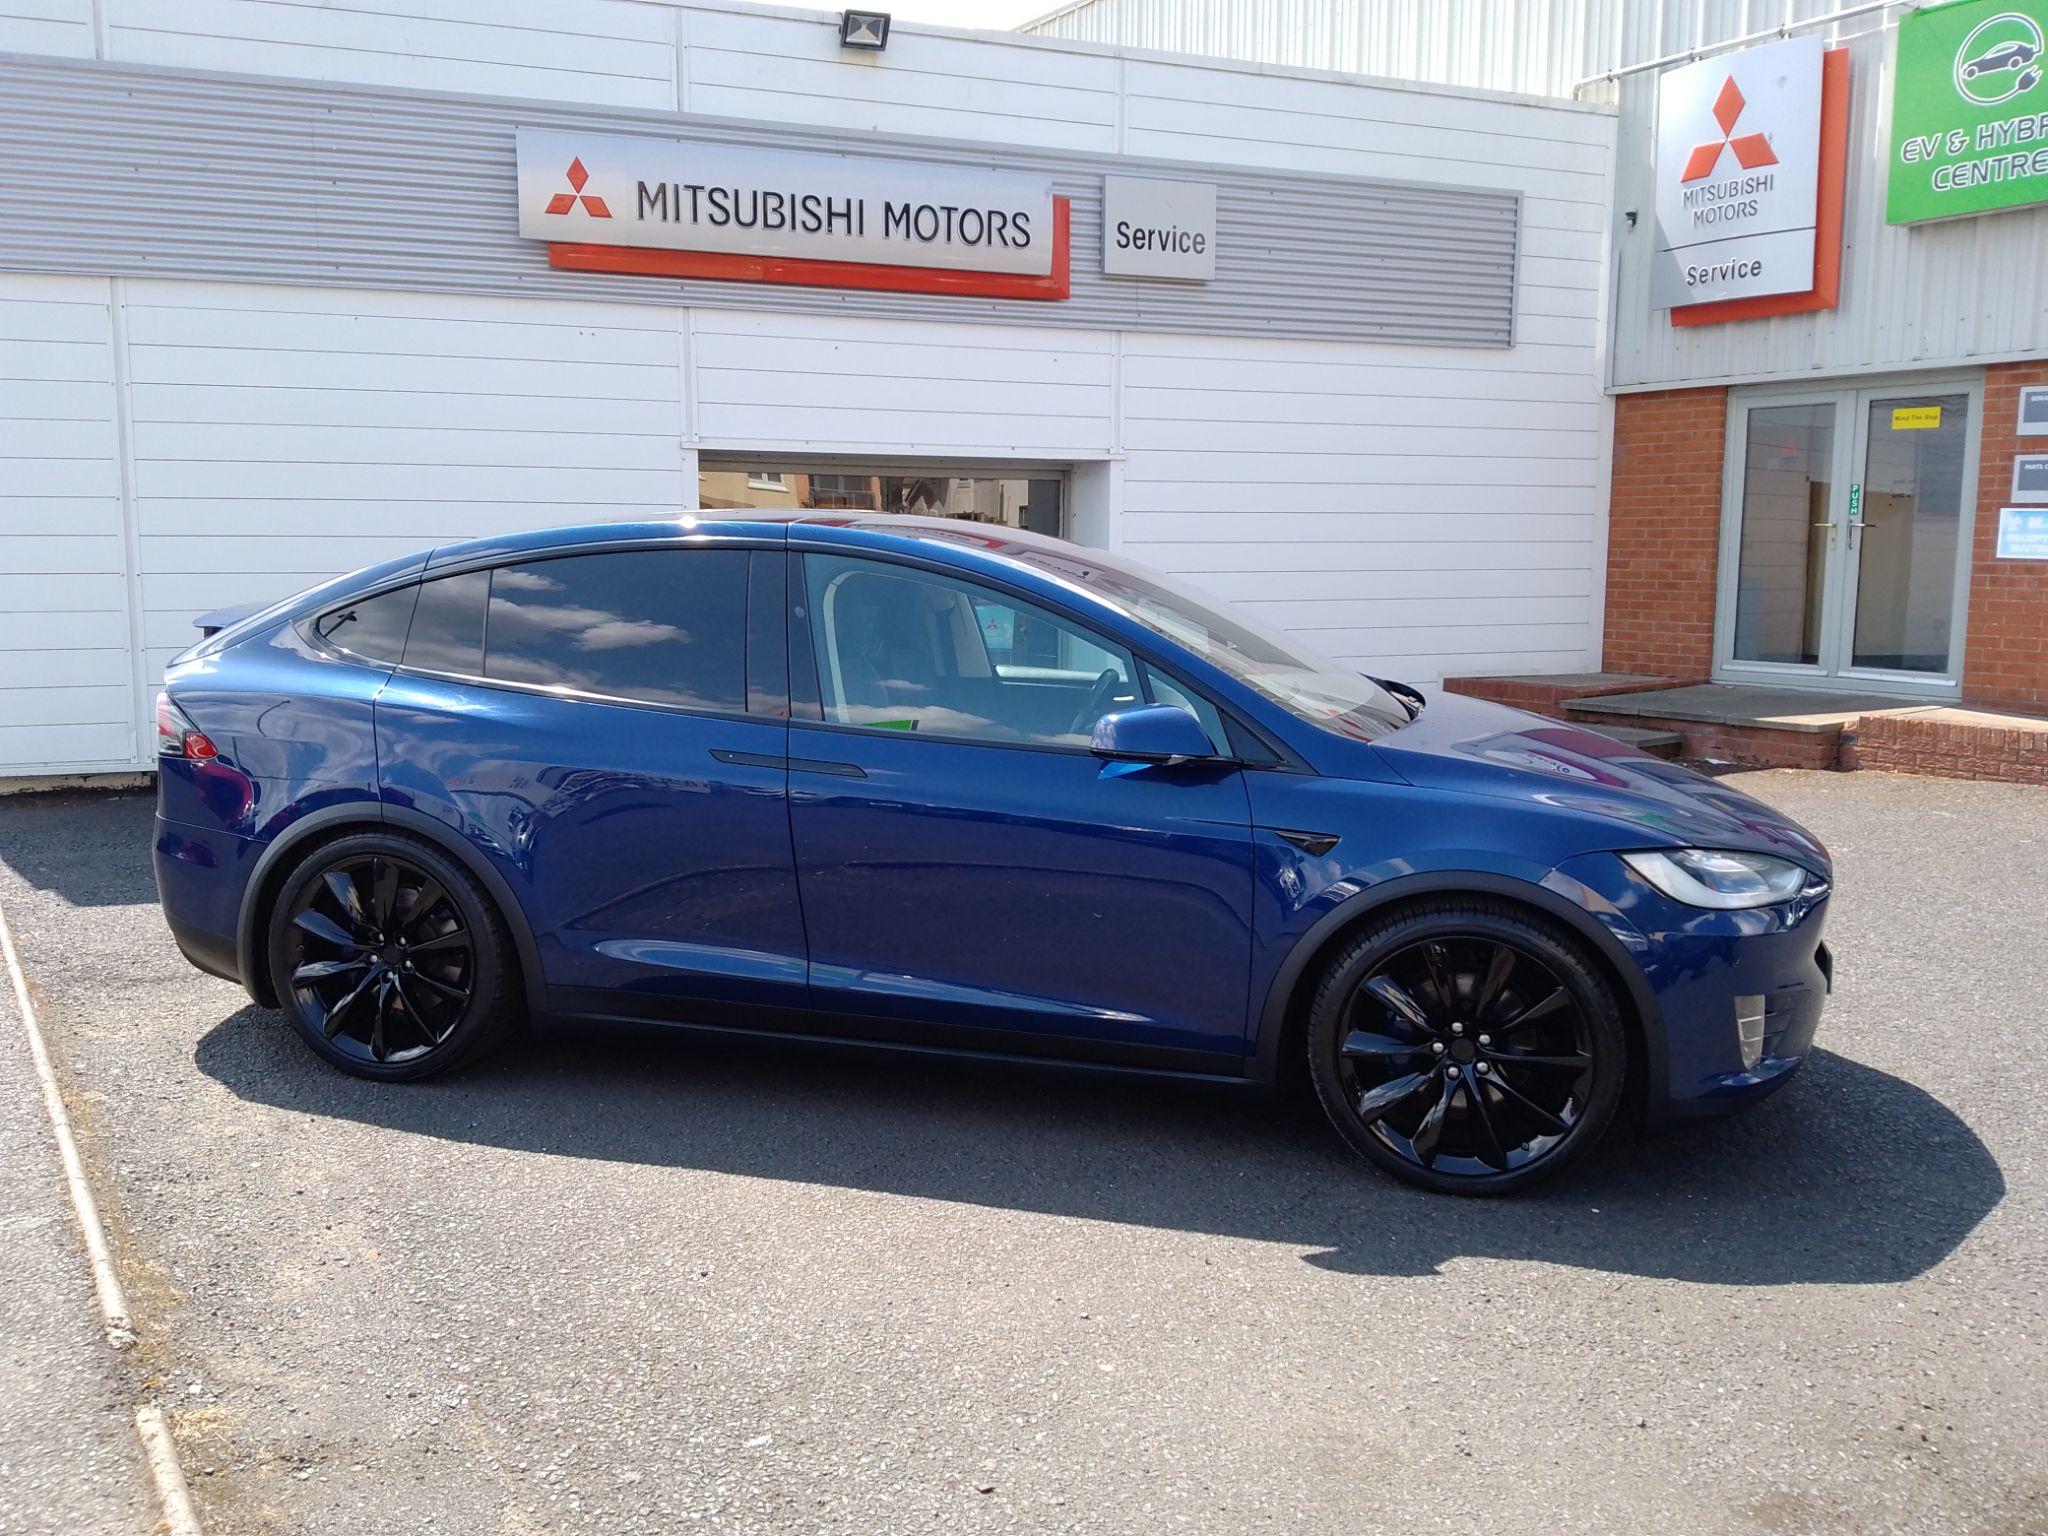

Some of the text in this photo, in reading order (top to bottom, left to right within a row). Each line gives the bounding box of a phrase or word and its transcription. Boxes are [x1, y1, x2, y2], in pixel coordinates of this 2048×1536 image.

[1901, 132, 1942, 163] EV
[1946, 128, 1969, 155] &
[1932, 147, 2048, 191] CENTRE
[1682, 173, 1775, 209] MITSUBISHI
[637, 180, 1032, 249] MITSUBISHI MOTORS
[1691, 198, 1759, 227] MOTORS
[1115, 210, 1207, 256] Service
[1686, 257, 1763, 286] Service
[1851, 484, 1859, 515] PUSH
